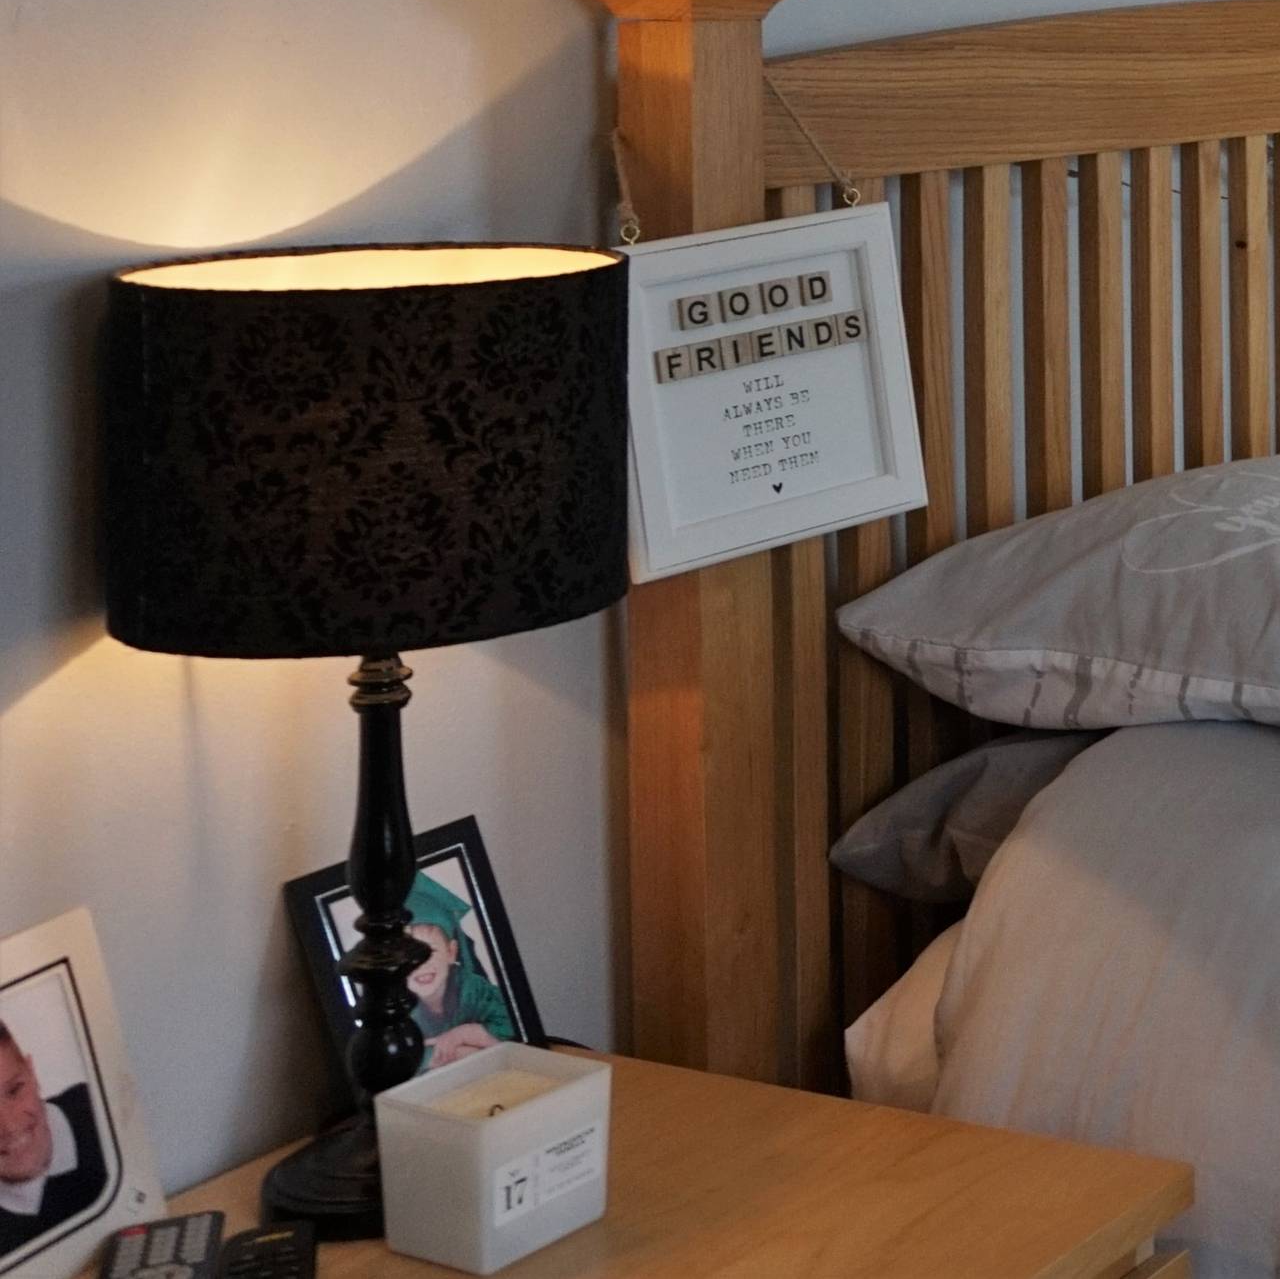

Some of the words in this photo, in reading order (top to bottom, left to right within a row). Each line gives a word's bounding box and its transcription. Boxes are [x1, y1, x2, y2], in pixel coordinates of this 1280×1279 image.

[687, 275, 828, 325] GOOD
[667, 314, 862, 379] FRIENDS
[743, 374, 784, 394] WILL
[724, 396, 784, 421] ALWAYS
[789, 389, 810, 406] BE
[743, 414, 796, 438] THERE
[731, 440, 774, 462] WHEN
[781, 431, 811, 450] YOU
[729, 463, 772, 484] NEED
